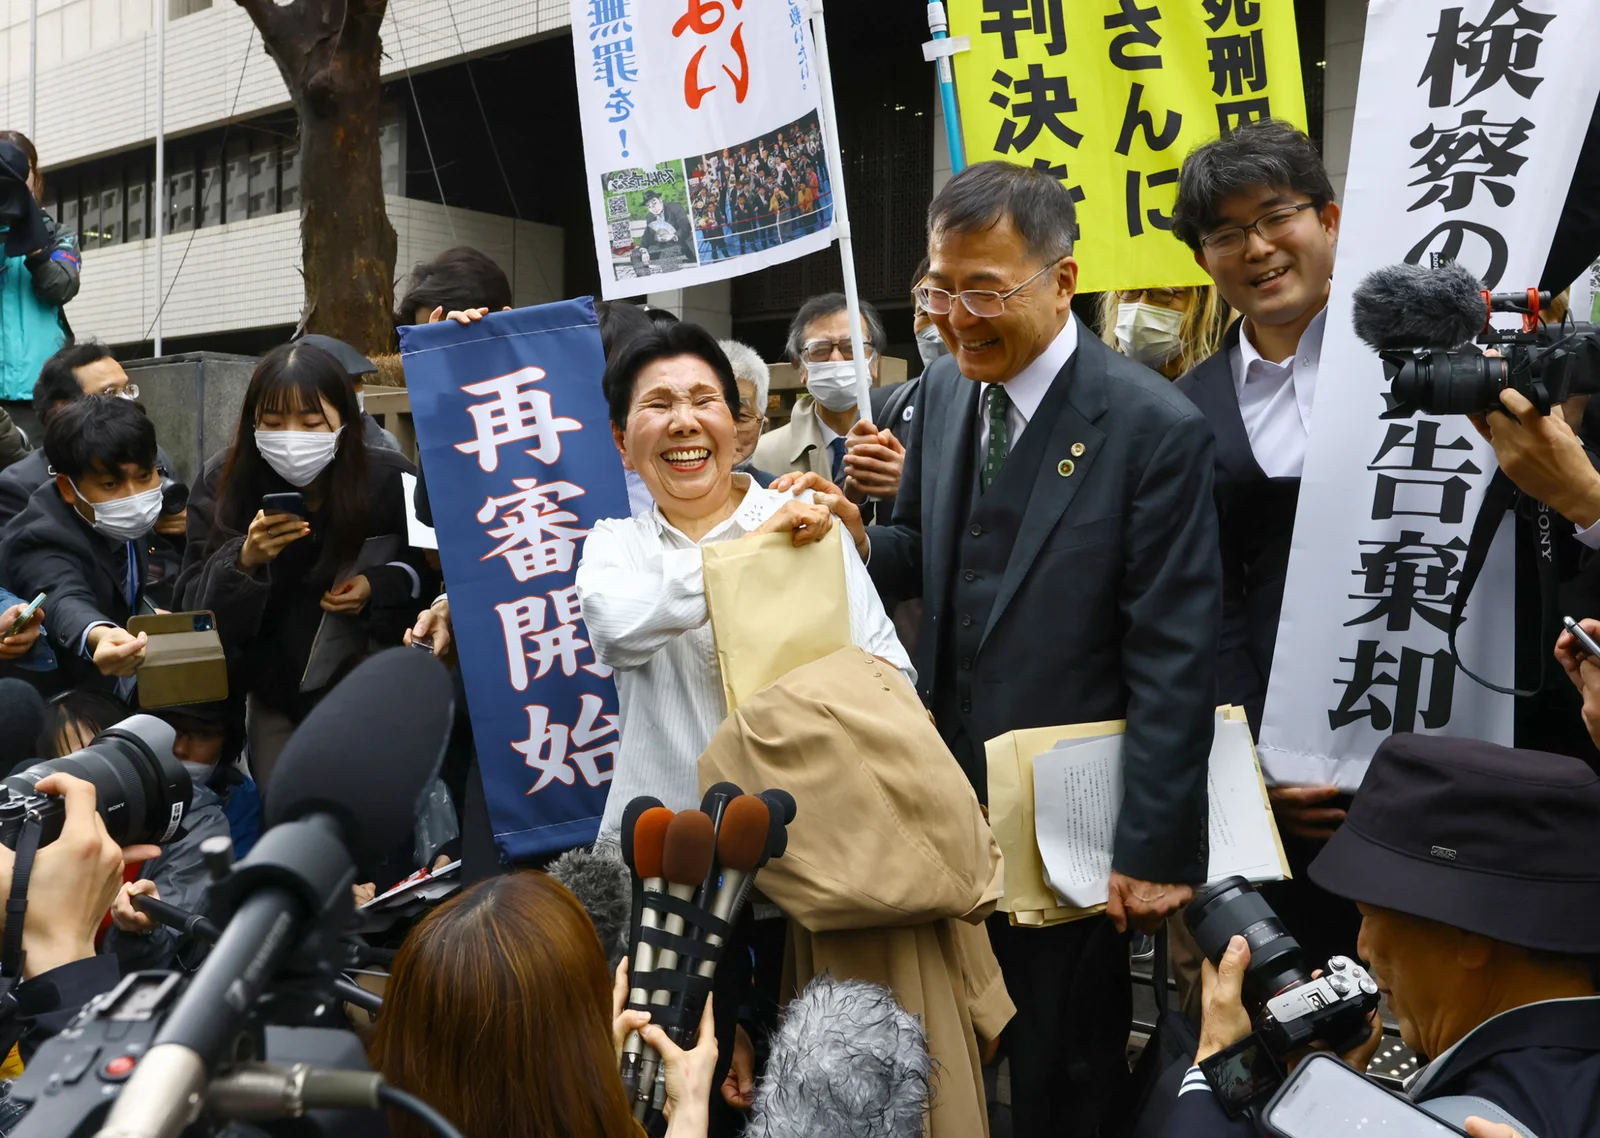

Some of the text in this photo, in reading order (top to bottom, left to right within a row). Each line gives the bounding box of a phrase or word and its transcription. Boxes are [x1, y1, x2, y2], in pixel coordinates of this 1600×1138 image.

[980, 0, 1086, 241] 判決
[454, 365, 620, 796] 再審開始
[1327, 0, 1557, 735] 検察の告棄却
